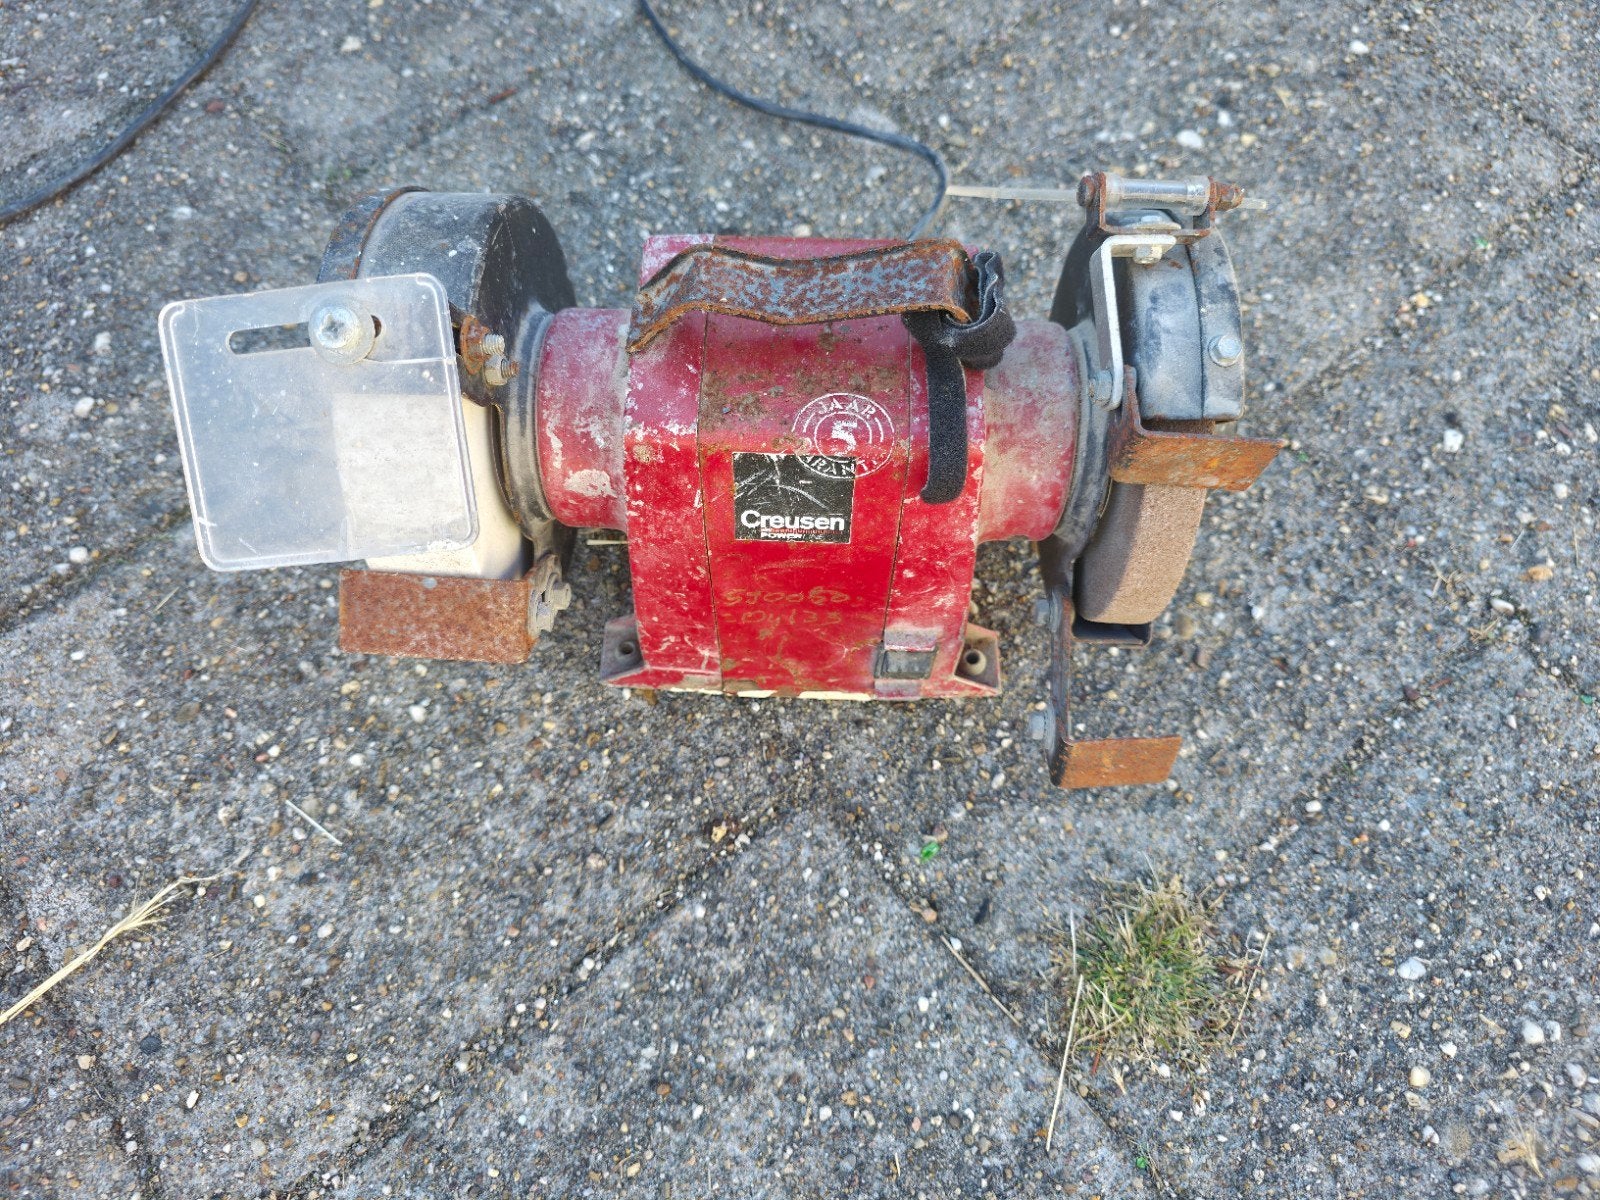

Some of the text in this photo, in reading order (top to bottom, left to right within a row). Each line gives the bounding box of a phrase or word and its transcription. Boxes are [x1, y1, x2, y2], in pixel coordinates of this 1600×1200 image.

[818, 398, 876, 419] JAAR
[831, 420, 857, 456] 5
[740, 510, 845, 531] Creusen
